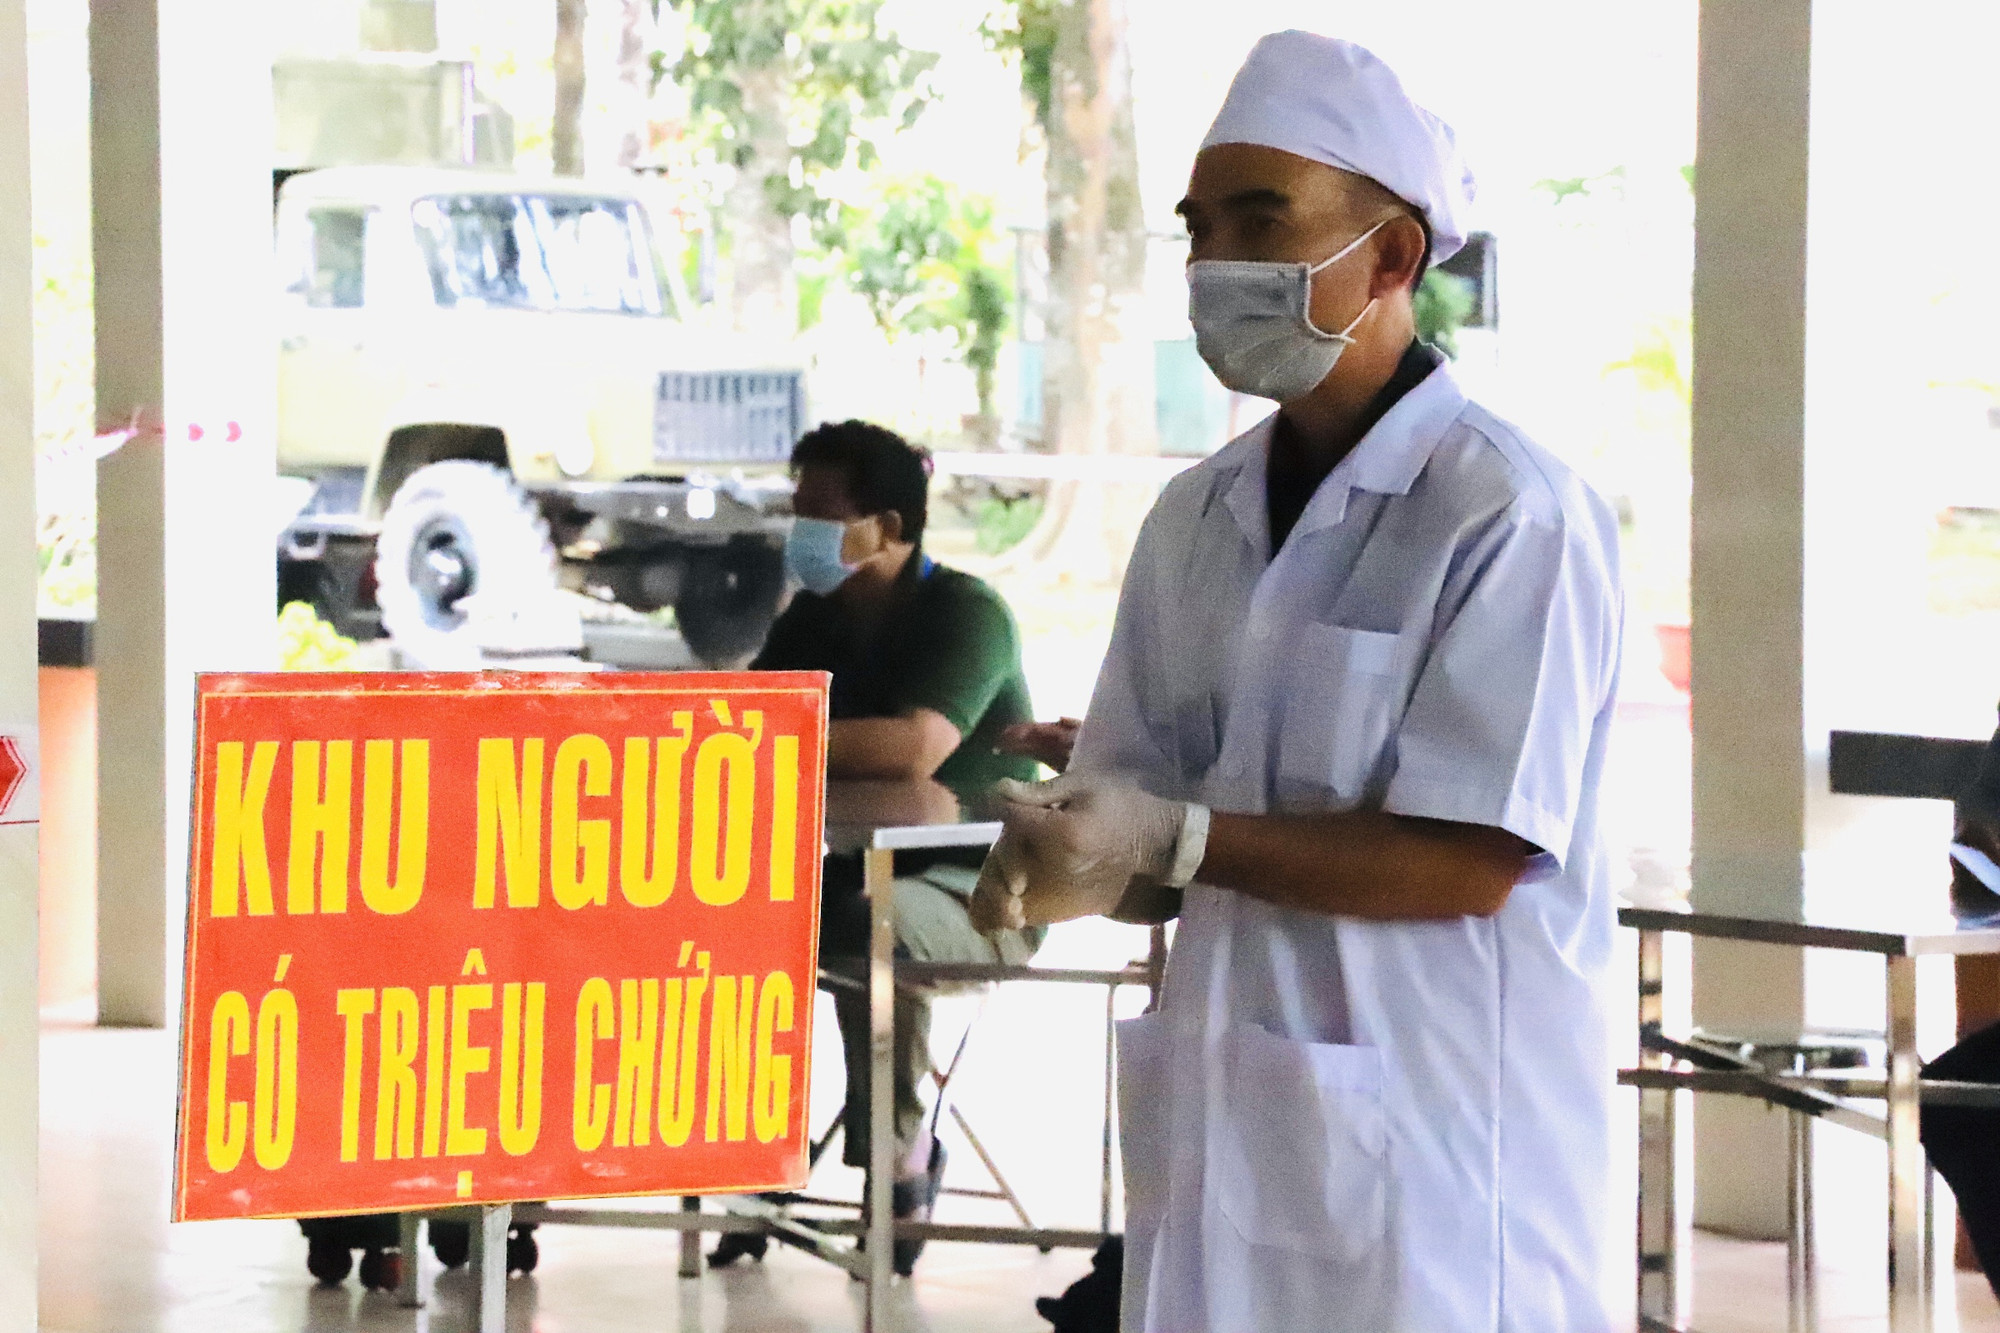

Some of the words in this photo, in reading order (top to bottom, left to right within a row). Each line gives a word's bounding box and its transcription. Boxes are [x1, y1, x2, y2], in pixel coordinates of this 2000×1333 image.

[210, 738, 430, 918] KHU
[472, 699, 800, 911] NGƯỜI
[205, 954, 299, 1172] CÓ
[336, 948, 546, 1198] TRIỆU
[572, 940, 795, 1153] CHỨNG
